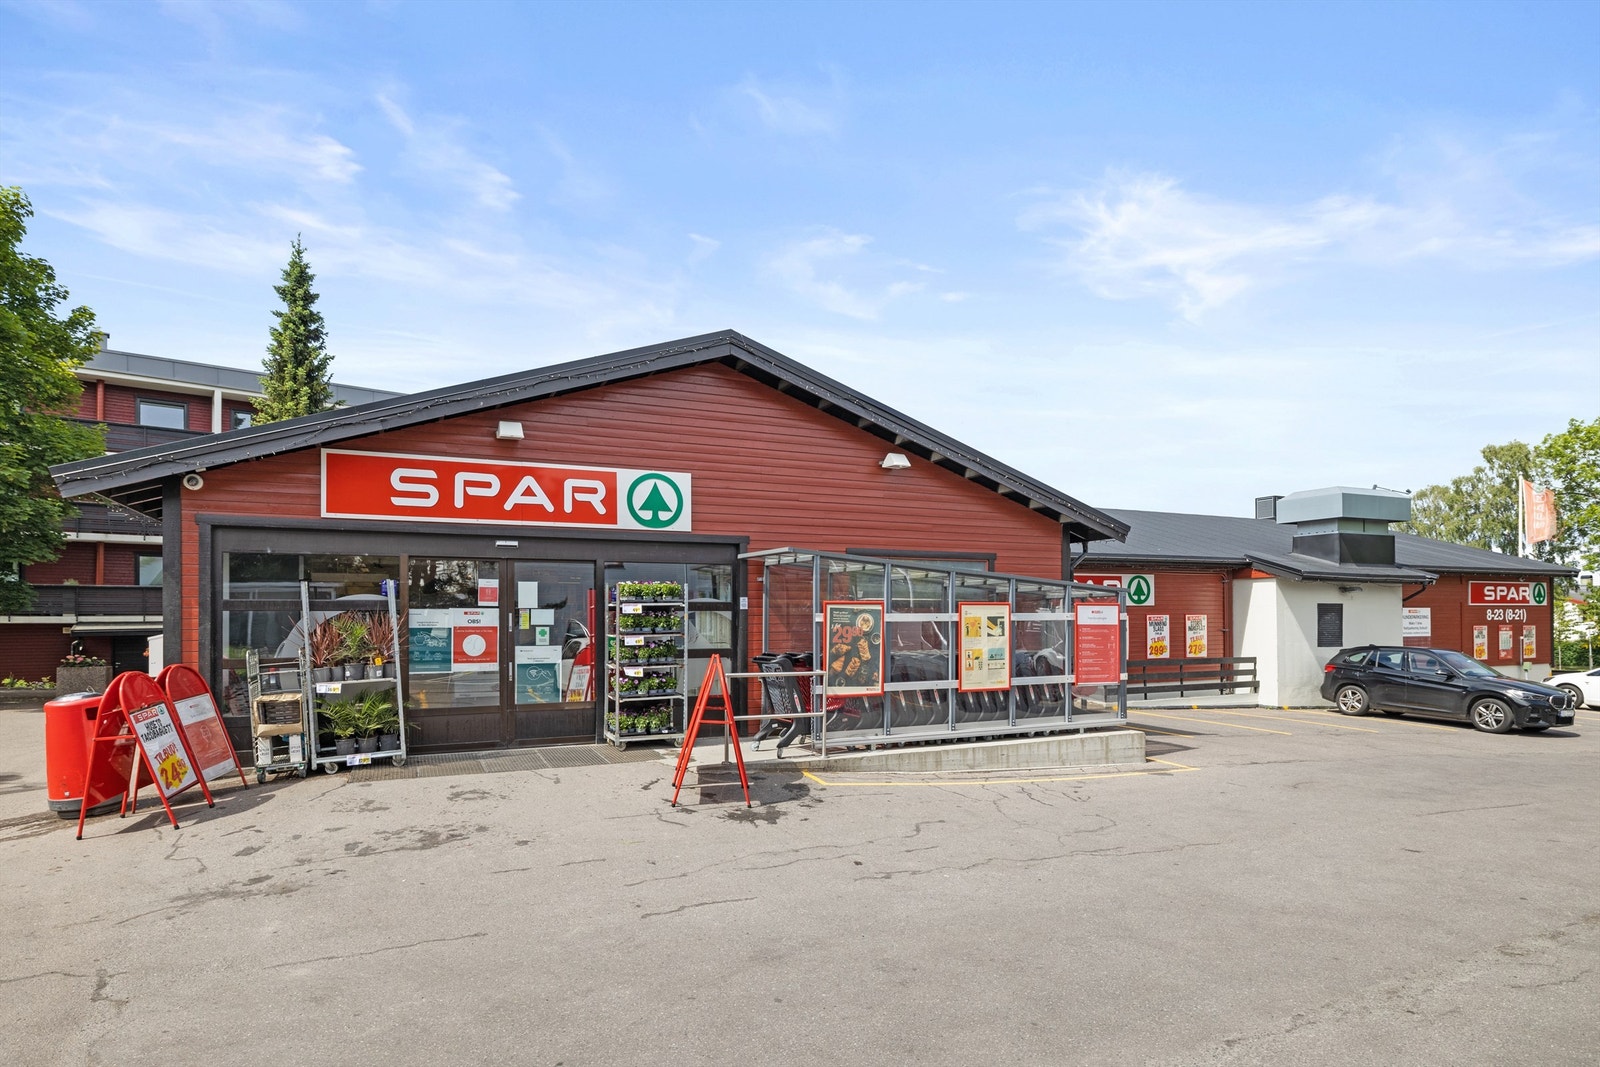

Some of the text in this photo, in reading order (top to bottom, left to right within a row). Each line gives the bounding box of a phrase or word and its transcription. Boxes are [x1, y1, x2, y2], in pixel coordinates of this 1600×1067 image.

[389, 467, 608, 515] SPAR
[1534, 492, 1547, 529] SPAR
[1483, 585, 1530, 602] SPAR
[1486, 608, 1527, 623] 8-23 (8-21)
[136, 708, 158, 722] SPAR
[154, 743, 178, 765] TILBUD!
